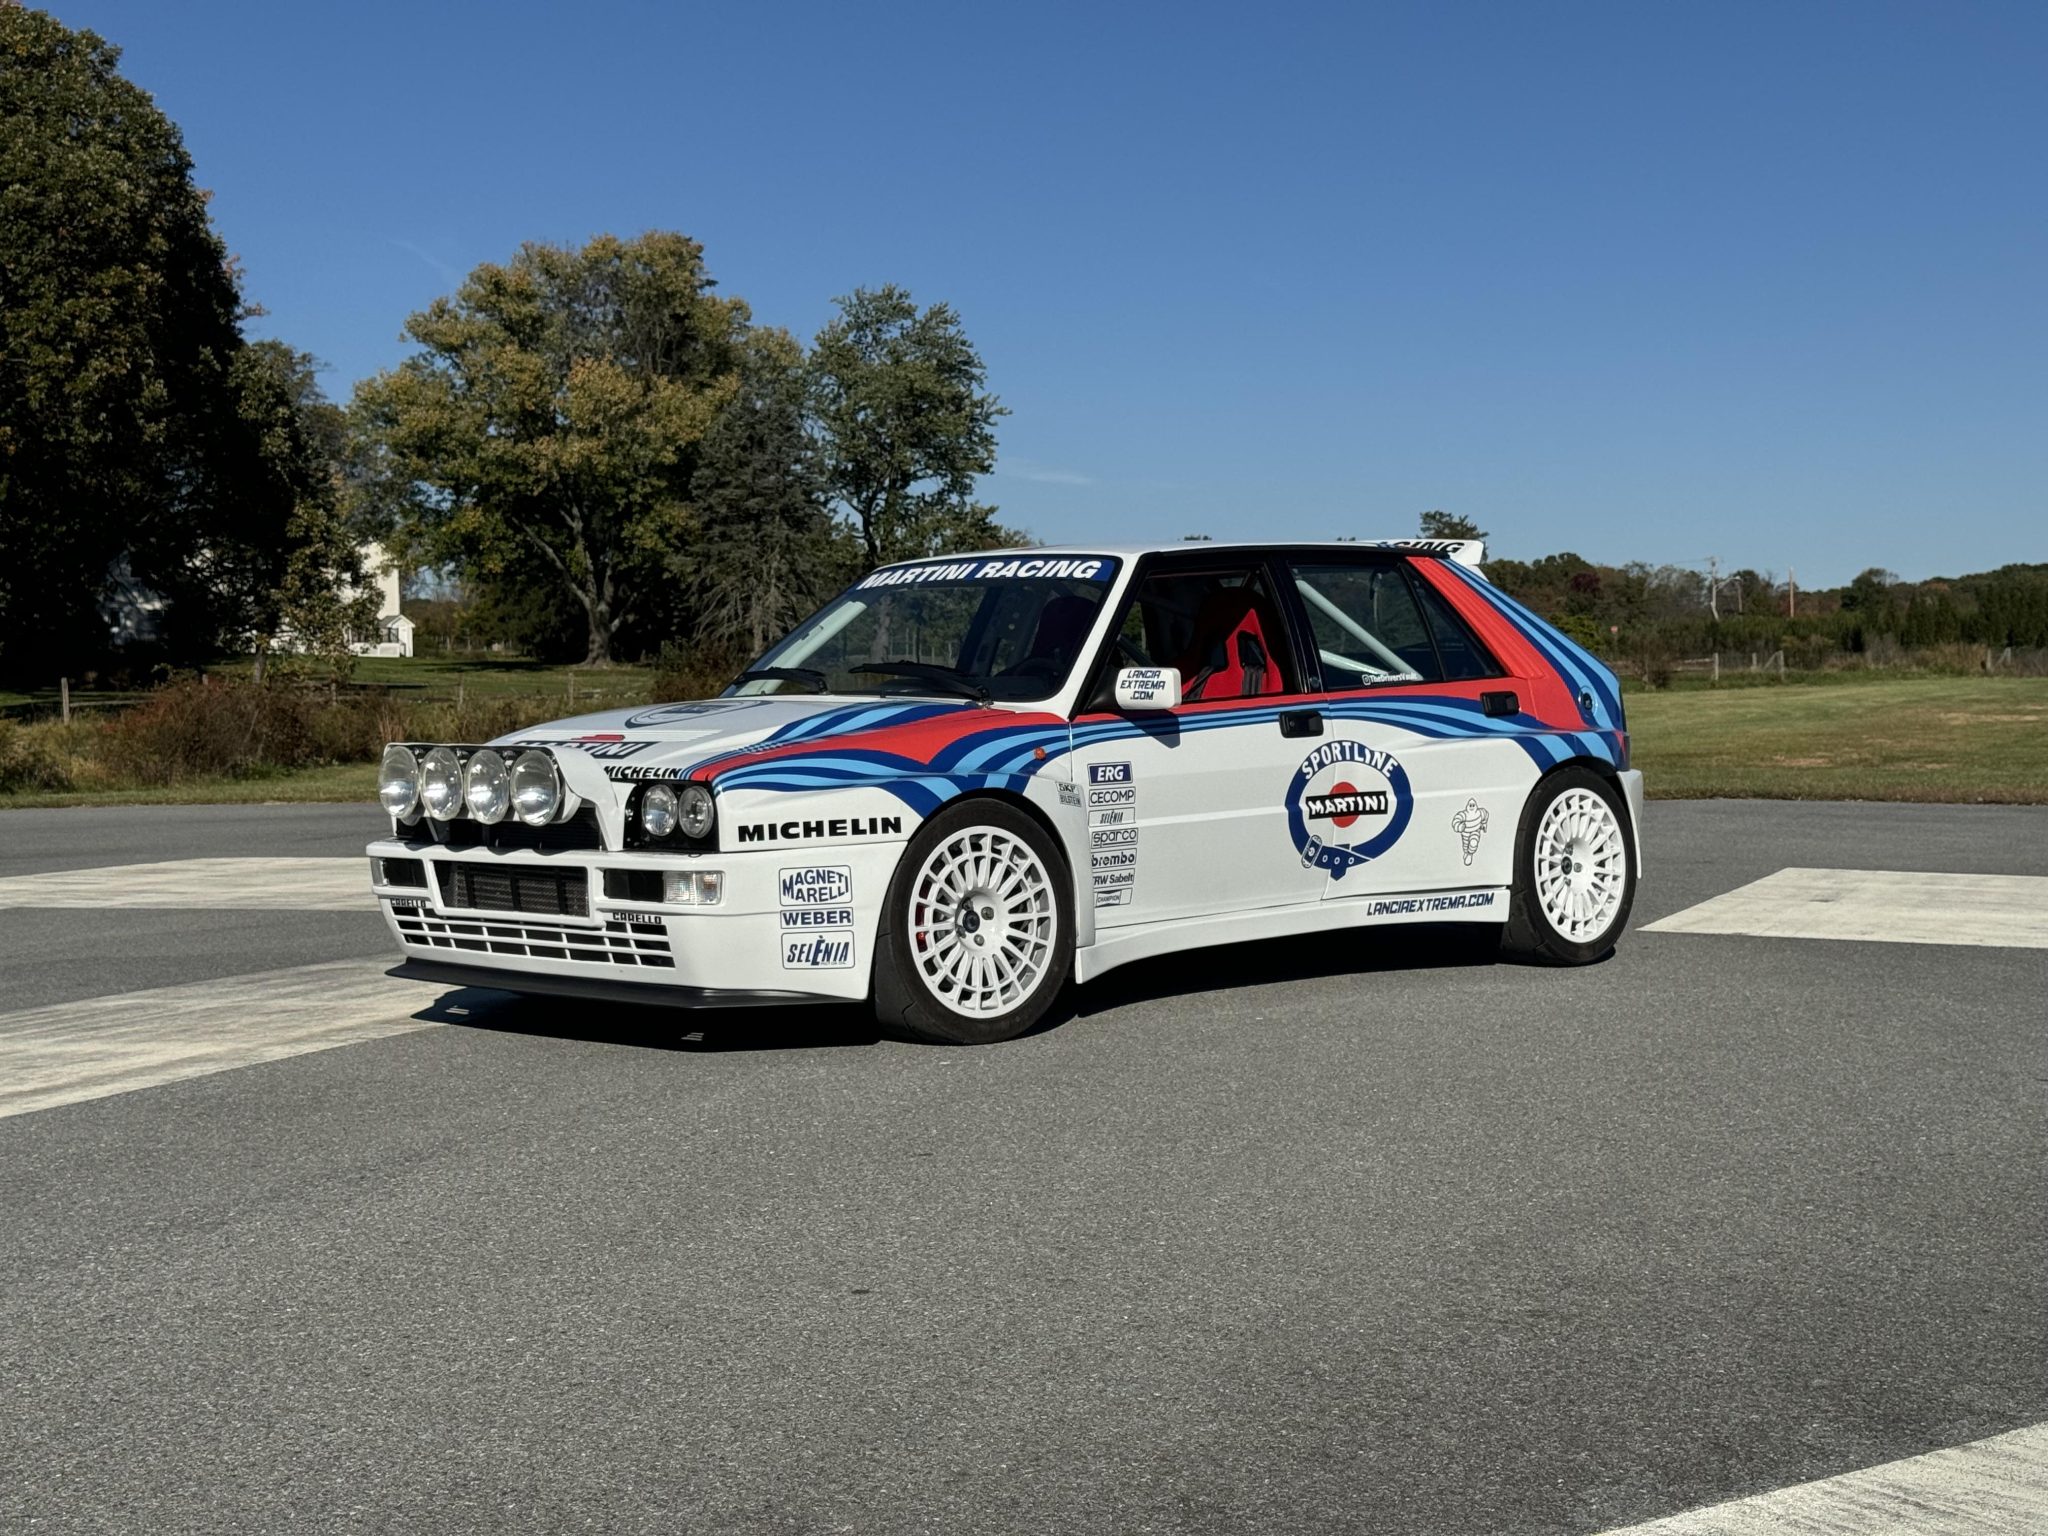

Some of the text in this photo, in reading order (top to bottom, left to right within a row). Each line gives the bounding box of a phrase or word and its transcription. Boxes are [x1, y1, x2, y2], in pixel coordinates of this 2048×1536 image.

[856, 560, 1102, 590] MARTINI RACING
[1127, 670, 1162, 679] LANCIA
[1120, 680, 1166, 690] EXTREMA
[1130, 691, 1154, 700] .COM
[1302, 741, 1398, 780] SPORTLINE
[1097, 765, 1124, 781] ERG
[1090, 789, 1134, 804] CECOMP
[1308, 795, 1386, 815] MARTINI
[738, 816, 902, 842] MICHELIN
[1093, 829, 1137, 847] sparco
[1092, 851, 1135, 867] brembo
[1366, 892, 1495, 916] LANCIAEXTREMA.COM
[782, 910, 851, 926] WEBER
